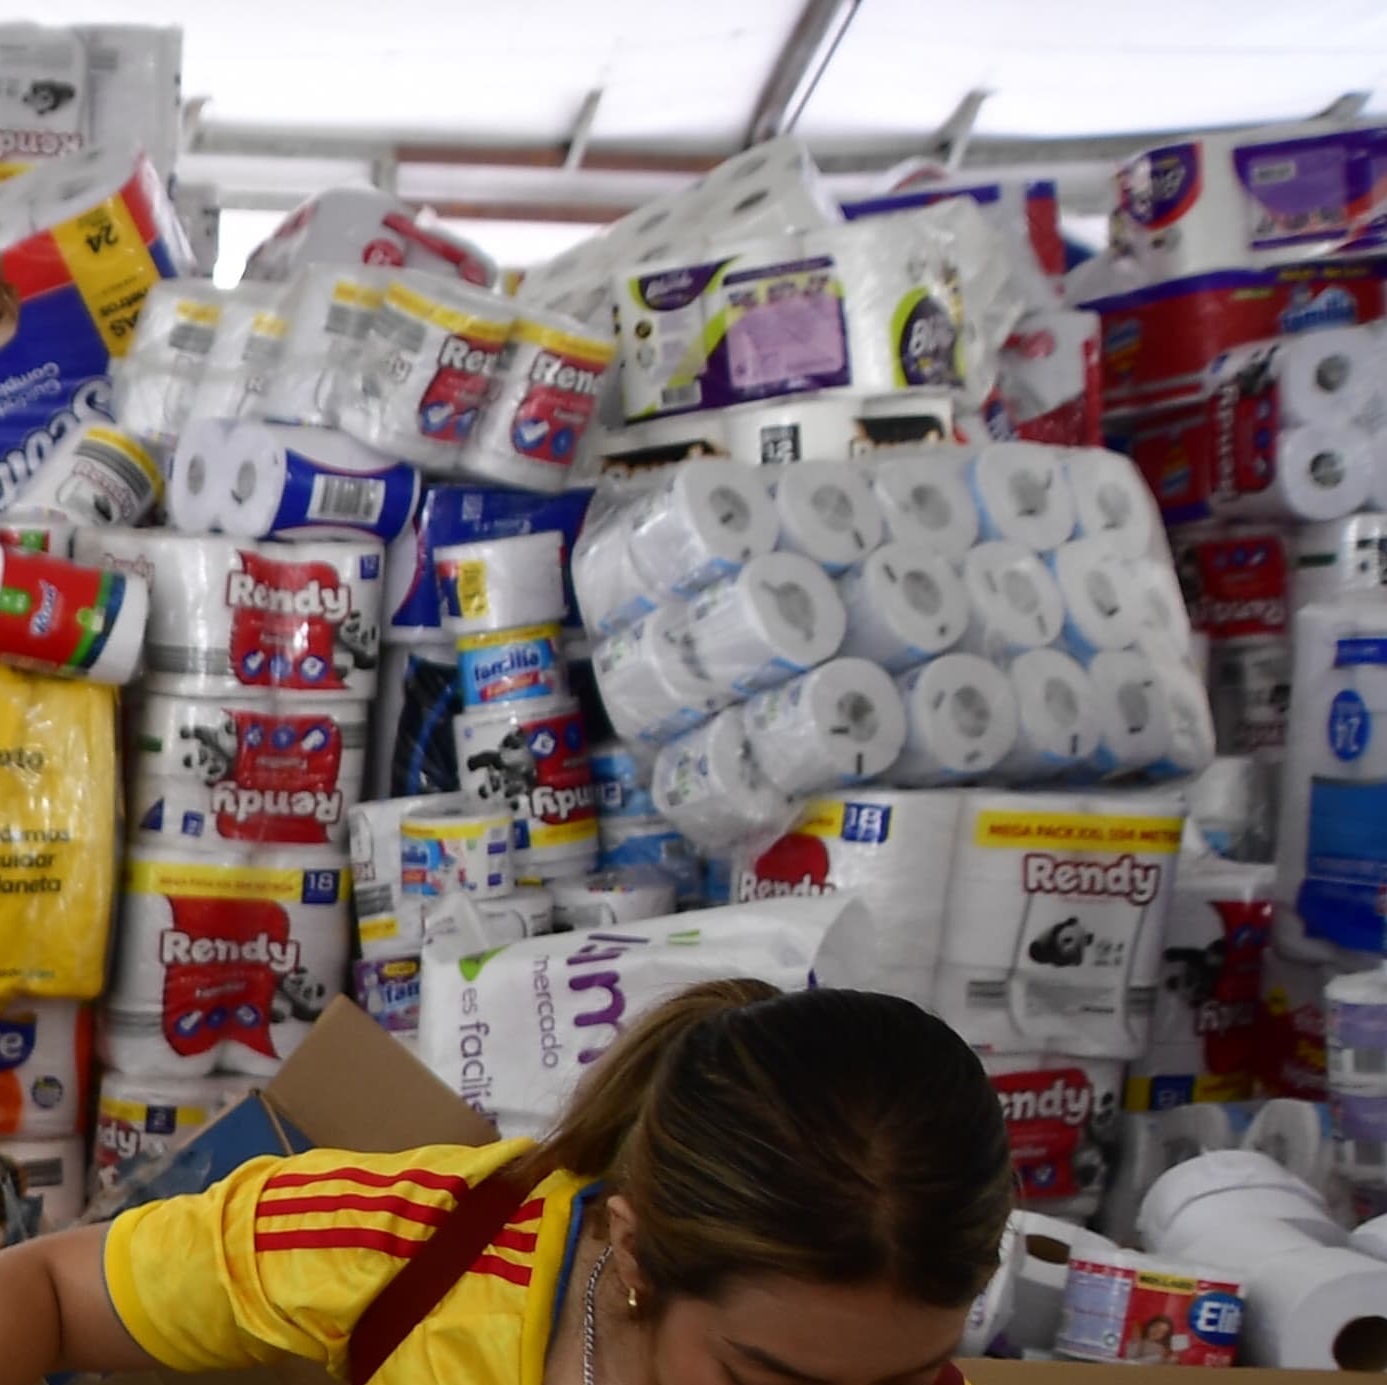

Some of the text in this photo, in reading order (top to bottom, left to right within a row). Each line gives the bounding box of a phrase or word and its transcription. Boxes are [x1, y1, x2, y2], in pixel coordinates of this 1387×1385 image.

[85, 223, 119, 254] 24
[227, 571, 352, 618] Rendy
[212, 786, 343, 823] Rendy
[306, 872, 334, 891] 18
[1024, 854, 1161, 905] Rendy
[162, 930, 300, 974] Rendy
